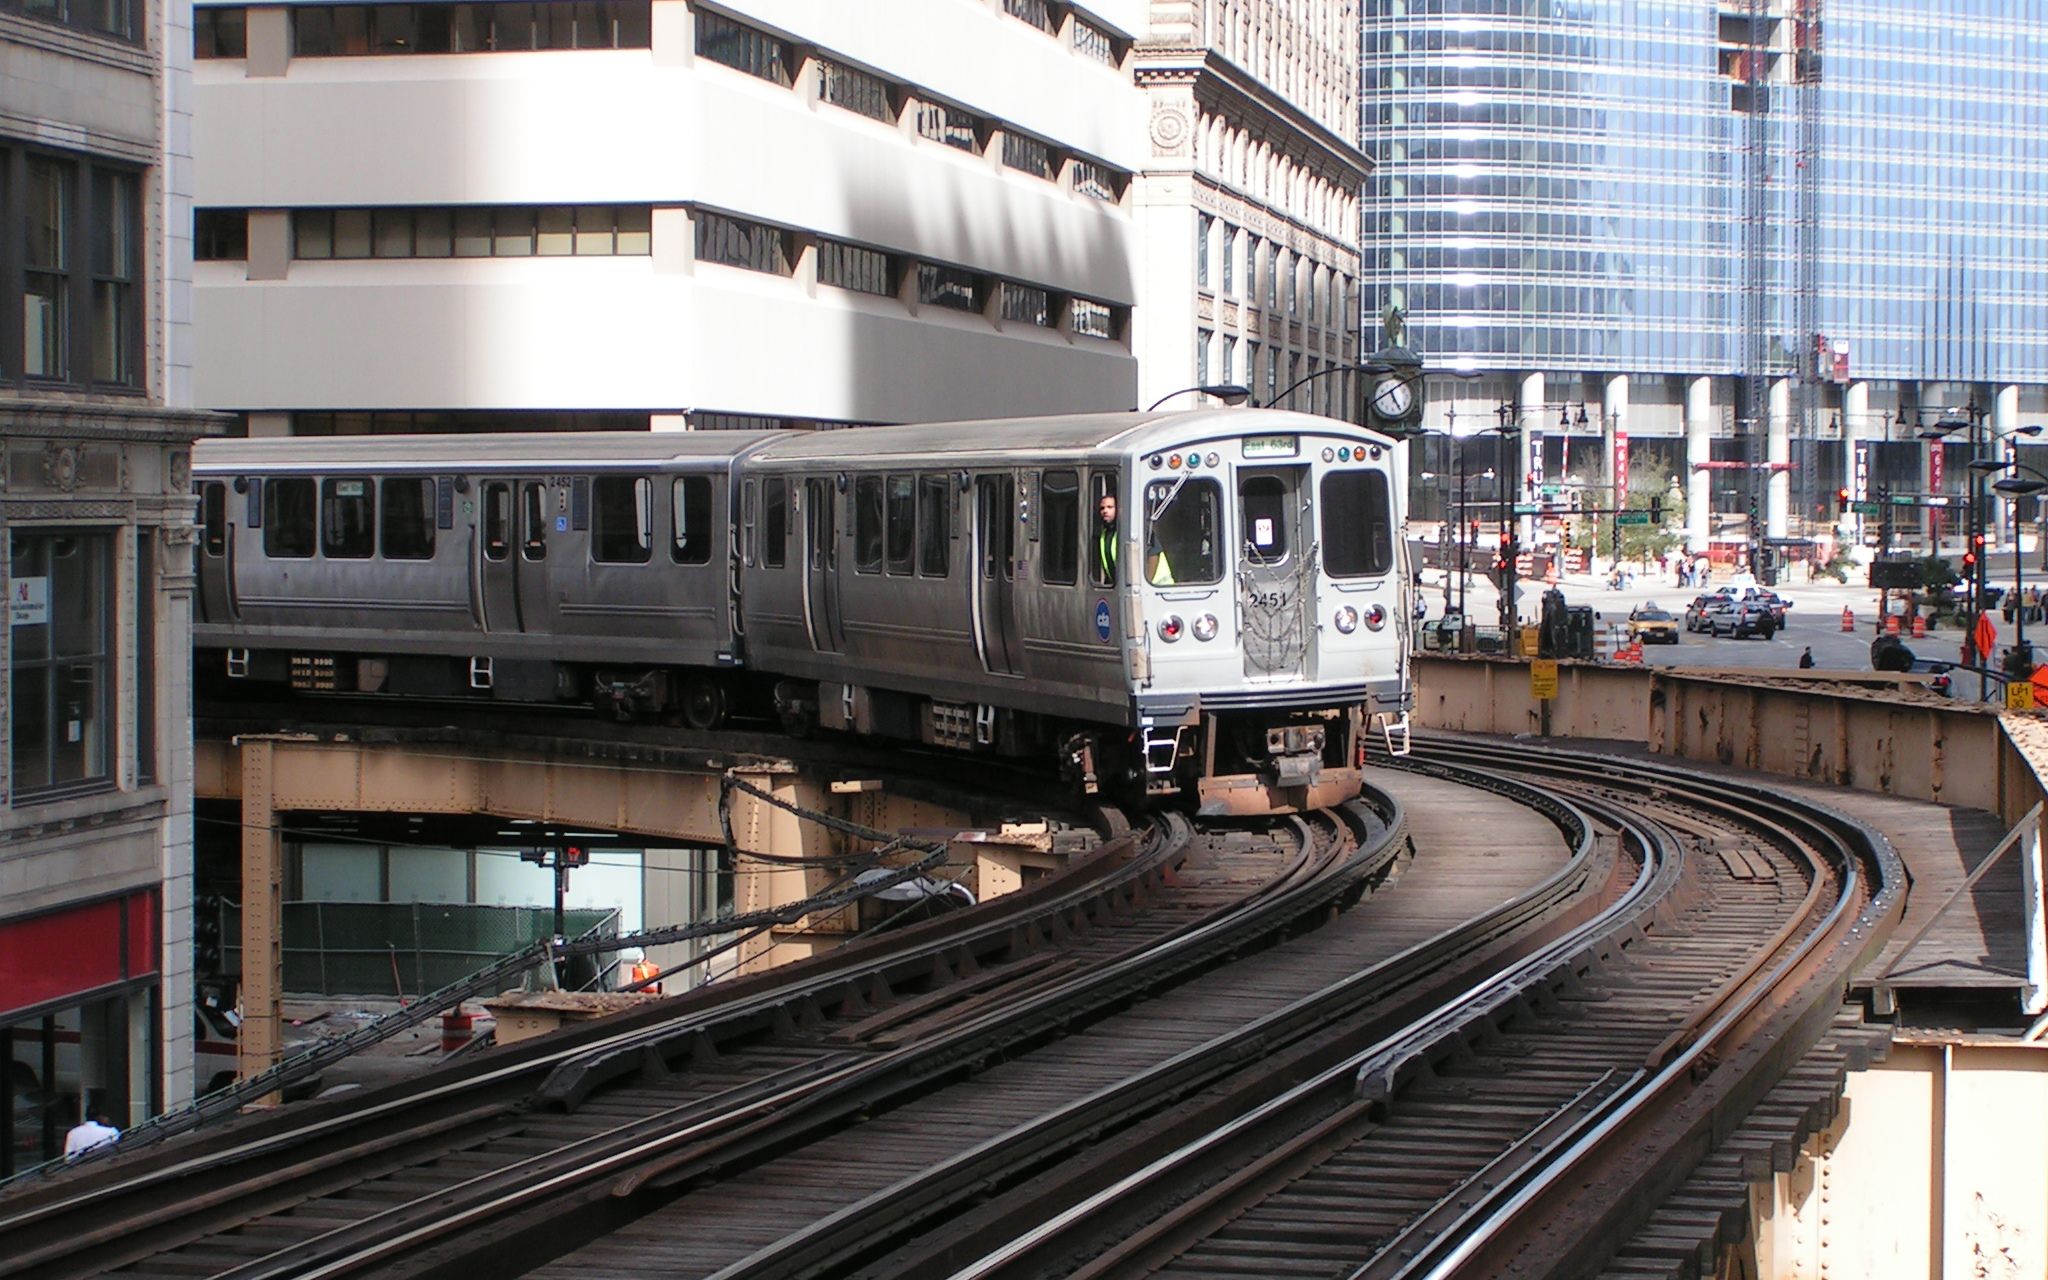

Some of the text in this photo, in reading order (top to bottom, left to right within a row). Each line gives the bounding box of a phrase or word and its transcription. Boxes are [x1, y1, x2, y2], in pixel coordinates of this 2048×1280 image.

[1243, 438, 1294, 451] East 63rd
[1856, 448, 1867, 503] TRUM
[1249, 592, 1287, 608] 2451
